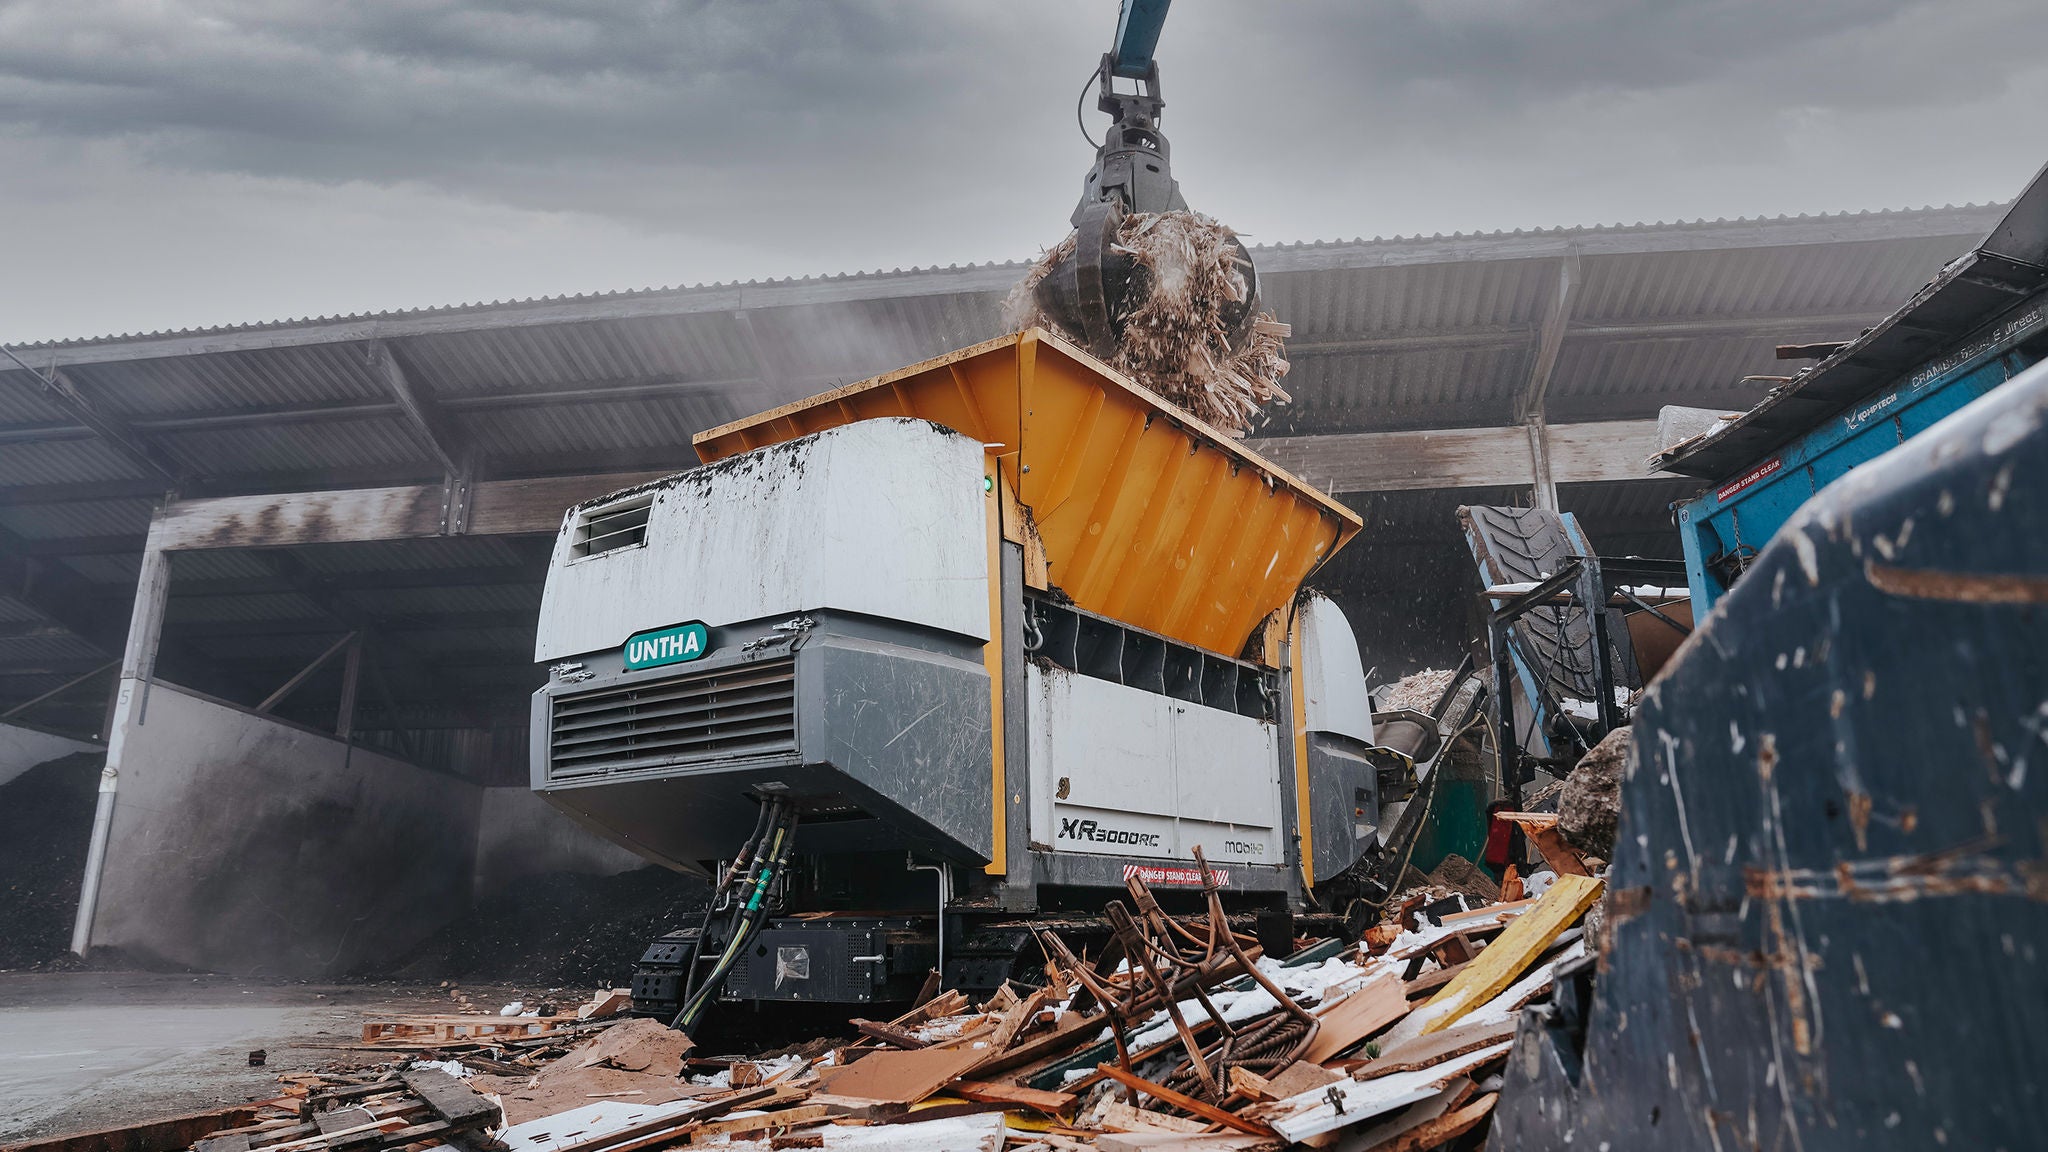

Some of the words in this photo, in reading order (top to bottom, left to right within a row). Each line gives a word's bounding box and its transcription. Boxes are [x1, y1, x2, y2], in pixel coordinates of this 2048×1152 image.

[1857, 393, 1897, 422] KOMPTECH
[1718, 482, 1741, 500] DANGER
[1740, 472, 1760, 487] STAND
[1760, 460, 1780, 475] CLEAR
[629, 631, 699, 664] UNTHA
[1225, 840, 1264, 855] mobile
[1140, 869, 1165, 881] DANGER
[1166, 871, 1184, 881] STAND
